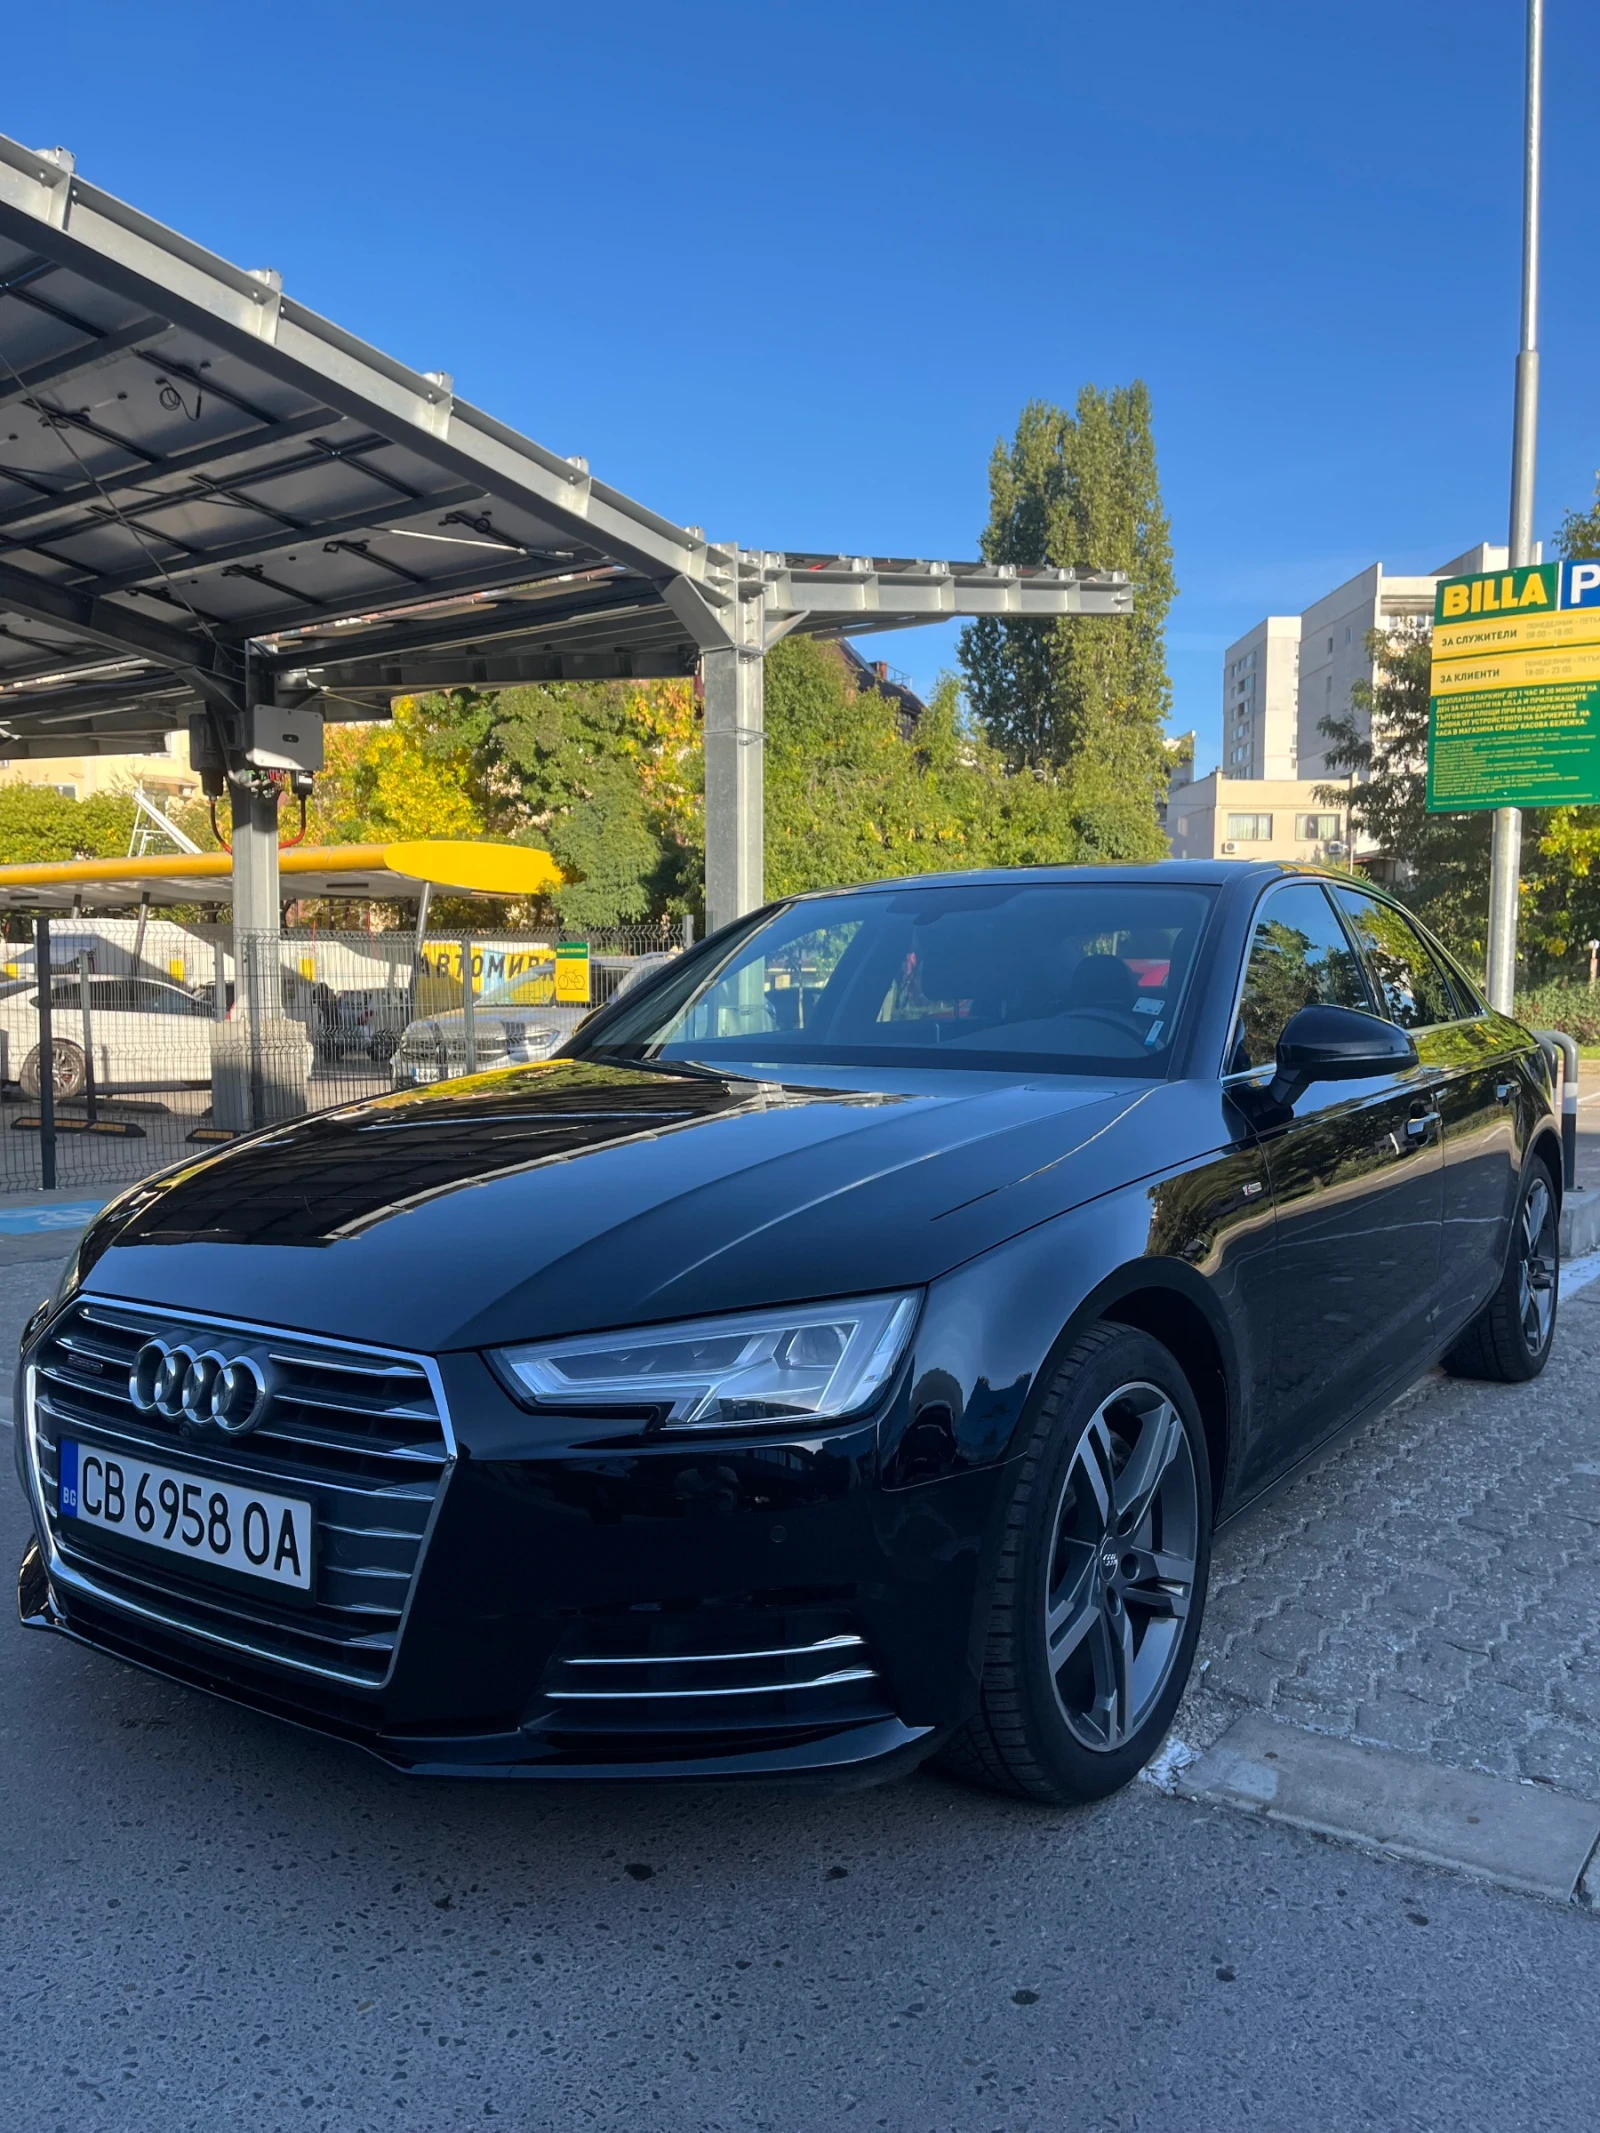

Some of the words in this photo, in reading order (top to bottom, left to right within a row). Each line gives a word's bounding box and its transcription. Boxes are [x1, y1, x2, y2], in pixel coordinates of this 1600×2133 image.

[1570, 564, 1600, 604] P
[1443, 573, 1548, 618] BILLA
[1442, 637, 1454, 647] ЗА
[1456, 630, 1518, 645] СЛУЖИТЕЛИ
[1440, 674, 1452, 684] ЗА
[1454, 668, 1500, 682] КЛИЕНТИ
[1475, 693, 1505, 702] ПАРКИНГ
[1524, 690, 1538, 698] ЧАС
[1556, 686, 1586, 695] МИНУТИ
[1436, 712, 1473, 721] ТЪРГОВСКИ
[1566, 702, 1576, 710] НА
[1460, 702, 1491, 711] КЛИЕНТИ
[1492, 701, 1501, 709] НА
[1503, 699, 1522, 708] BILLA
[1523, 698, 1529, 706] И
[1436, 720, 1460, 729] ТАЛОНА
[1524, 714, 1533, 722] НА
[1580, 709, 1590, 717] НА
[1435, 729, 1452, 737] КАСА
[1459, 726, 1494, 735] МАГАЗИНА
[1521, 721, 1548, 730] КАСОВА
[63, 1487, 77, 1507] BG
[135, 1472, 232, 1554] 6958
